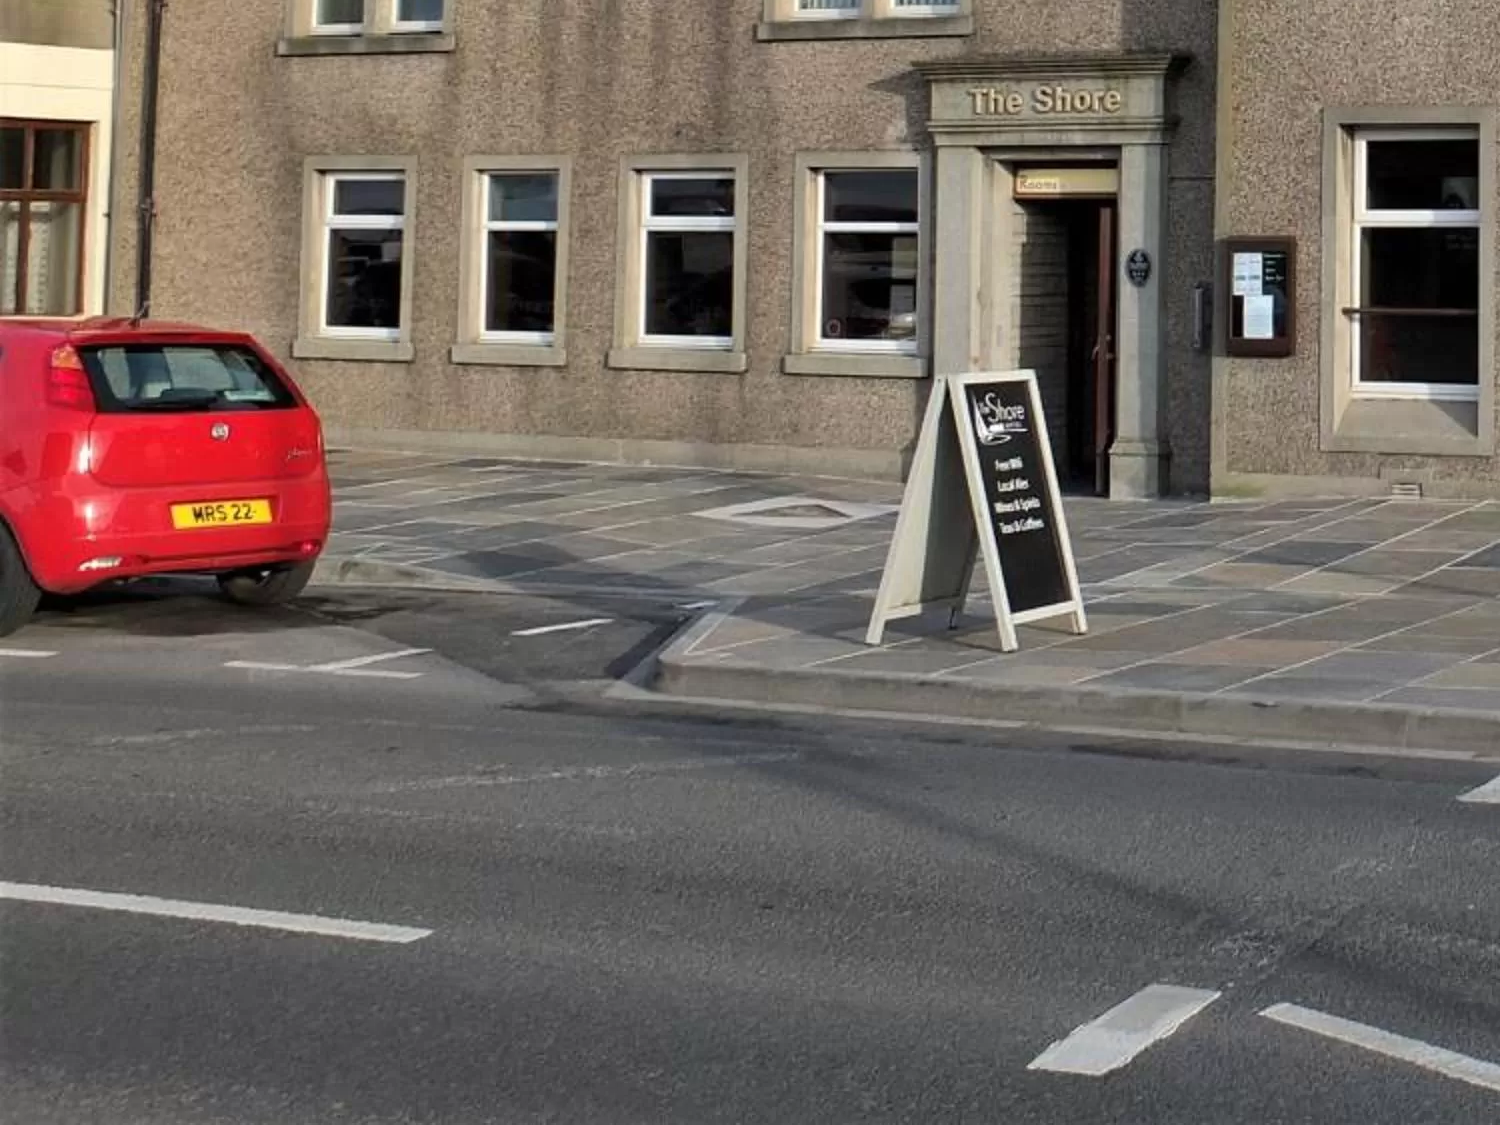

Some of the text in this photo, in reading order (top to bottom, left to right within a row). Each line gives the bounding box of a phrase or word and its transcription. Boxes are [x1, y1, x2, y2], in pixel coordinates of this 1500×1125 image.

[969, 85, 1121, 115] The Shore
[230, 503, 253, 520] 22
